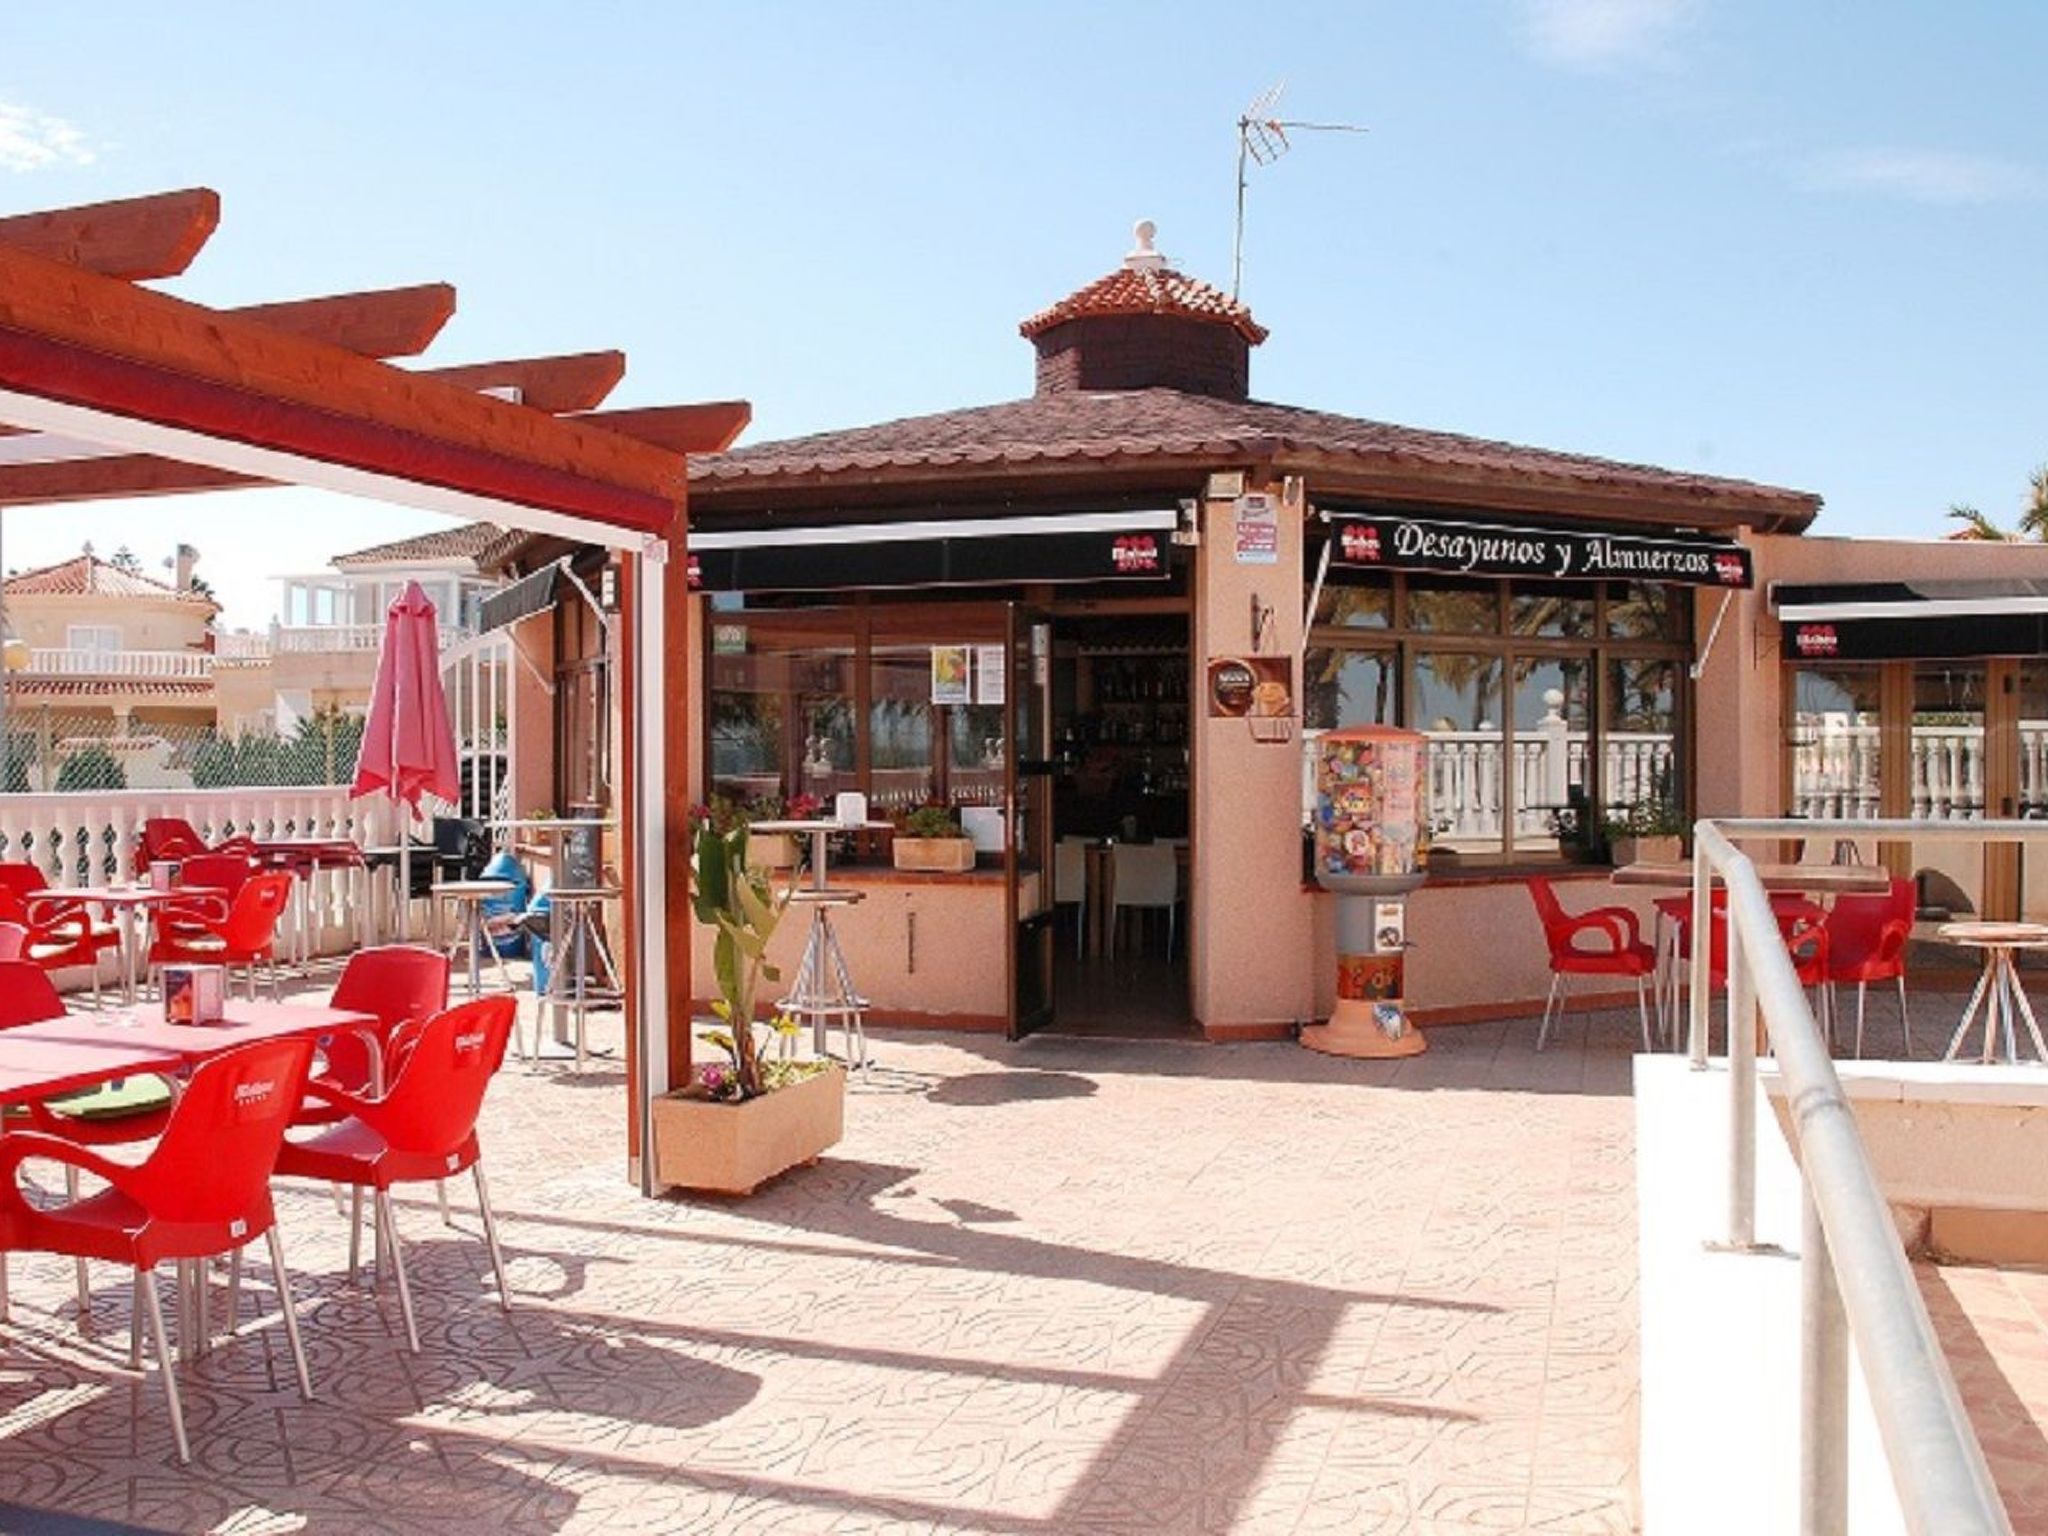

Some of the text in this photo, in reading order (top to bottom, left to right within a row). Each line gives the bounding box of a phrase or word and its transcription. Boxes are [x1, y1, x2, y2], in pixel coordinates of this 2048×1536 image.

[1394, 523, 1709, 577] Desayunos y Almuerzos
